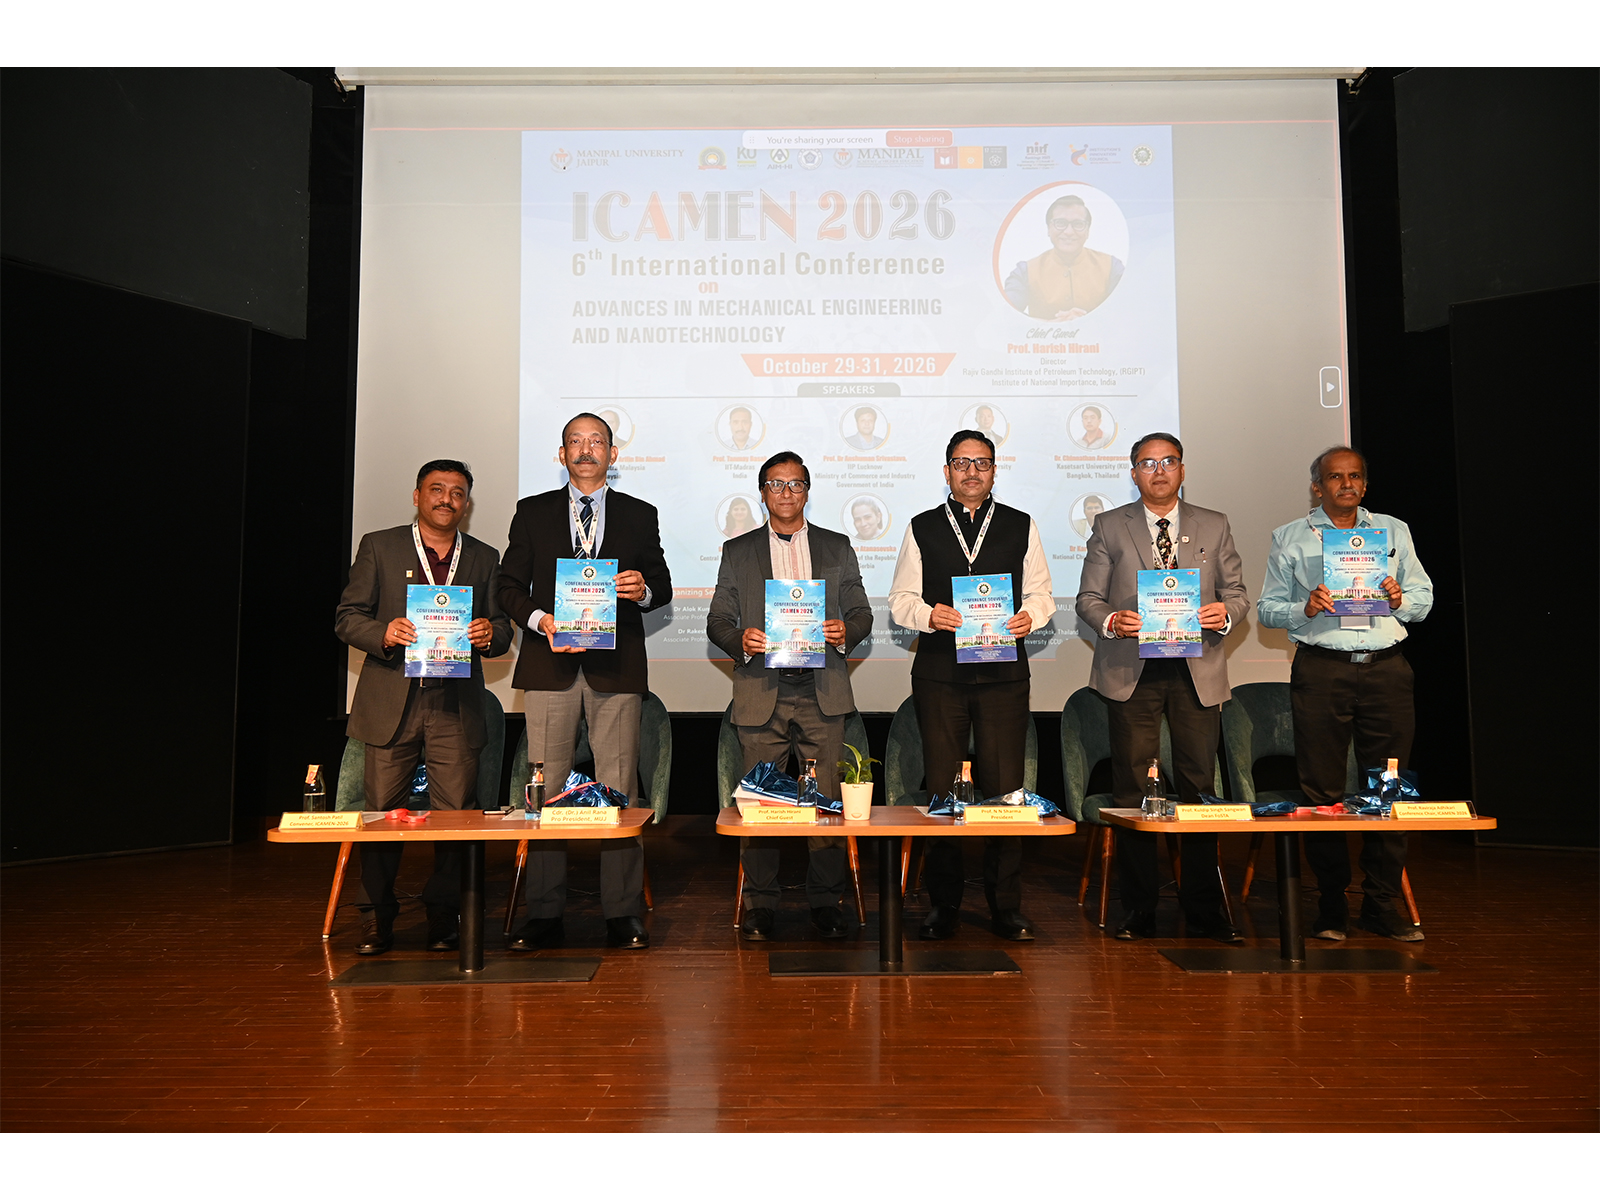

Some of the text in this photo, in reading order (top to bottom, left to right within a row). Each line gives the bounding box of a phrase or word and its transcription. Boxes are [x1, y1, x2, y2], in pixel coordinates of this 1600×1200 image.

[767, 136, 792, 144] You're
[794, 136, 824, 145] sharing
[826, 137, 845, 145] your
[893, 135, 945, 144] Stop sharing
[1026, 142, 1049, 153] nirf
[576, 149, 684, 158] MANIPAL UNIVERSITY
[737, 147, 757, 160] KU
[858, 148, 924, 159] MANIPAL
[576, 158, 610, 167] JAIPUR
[572, 188, 956, 243] ICAMEN 2026
[571, 249, 945, 277] 6th International Conference
[698, 280, 719, 294] on
[572, 298, 942, 317] ADVANCES IN MECHANICAL ENGINEERING
[572, 326, 786, 344] AND NANOTECHNOLOGY
[1026, 328, 1080, 339] Chief Guest
[1007, 343, 1100, 354] Prof. Harish Hirani
[763, 357, 936, 375] October 29-31, 2026
[963, 368, 978, 376] Rajiv
[1078, 368, 1118, 377] Technology,
[1120, 368, 1146, 376] (RGIPT)
[1060, 378, 1098, 387] Importance,
[822, 385, 876, 394] SPEAKERS
